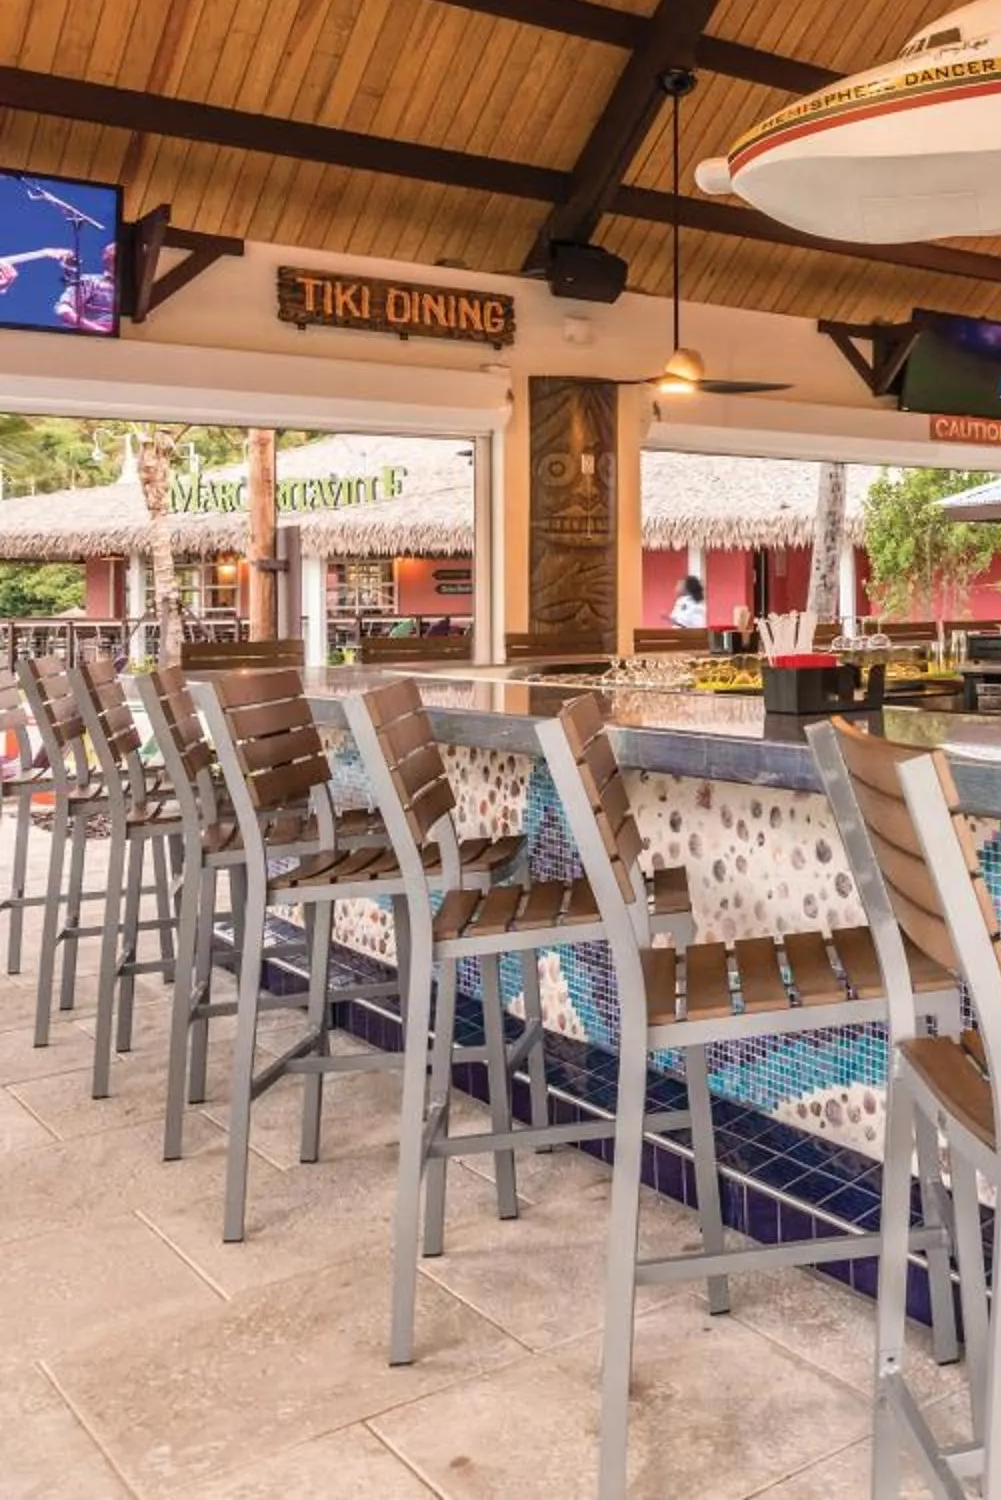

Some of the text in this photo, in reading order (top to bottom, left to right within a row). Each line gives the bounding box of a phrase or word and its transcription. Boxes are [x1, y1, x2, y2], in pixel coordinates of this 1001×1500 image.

[904, 58, 997, 87] DANCER
[295, 276, 504, 333] TIKI DINING
